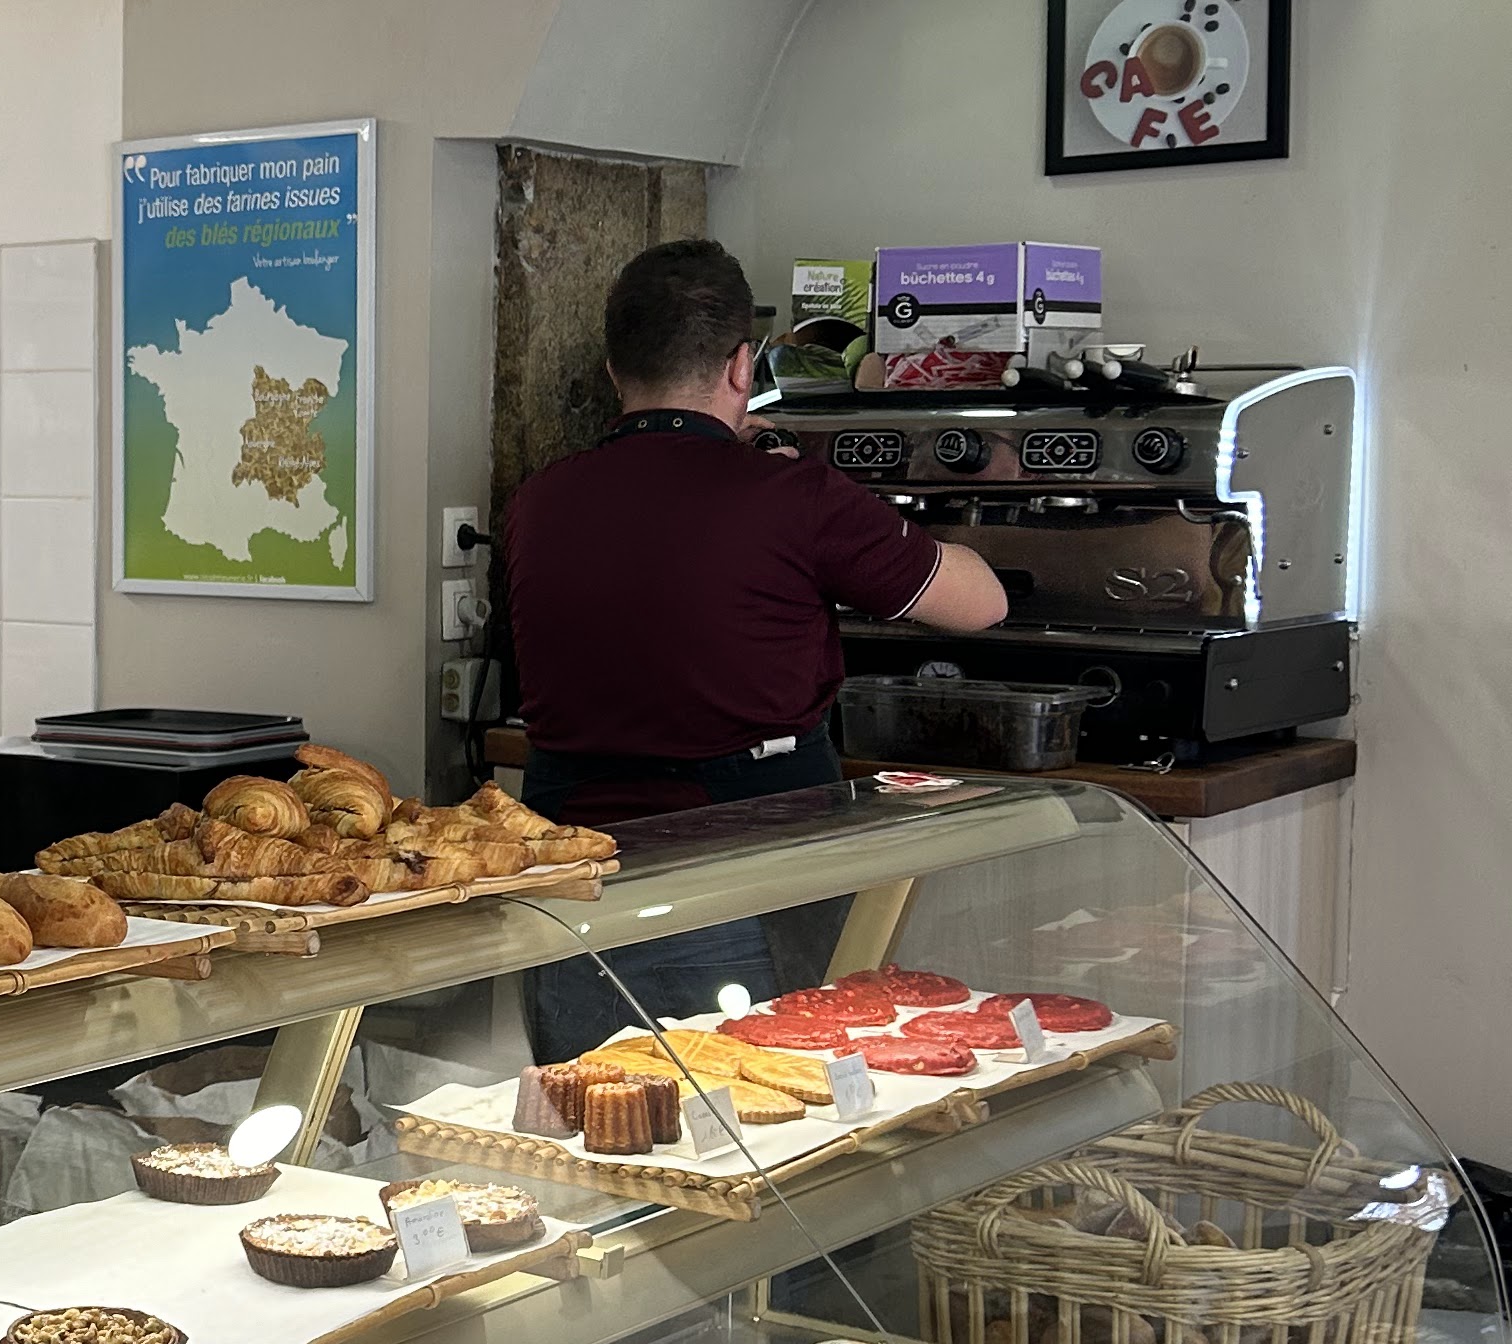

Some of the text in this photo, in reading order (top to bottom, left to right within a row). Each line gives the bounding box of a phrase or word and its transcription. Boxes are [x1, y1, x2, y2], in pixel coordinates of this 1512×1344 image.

[185, 161, 255, 187] fabriquer
[259, 161, 297, 181] mon
[302, 152, 340, 181] pain
[193, 192, 222, 215] des
[226, 189, 281, 213] farines
[284, 186, 341, 208] issues
[164, 218, 340, 249] des blés régionaux
[803, 281, 842, 294] création
[900, 270, 996, 286] bûchettes 4 g
[895, 302, 913, 318] G
